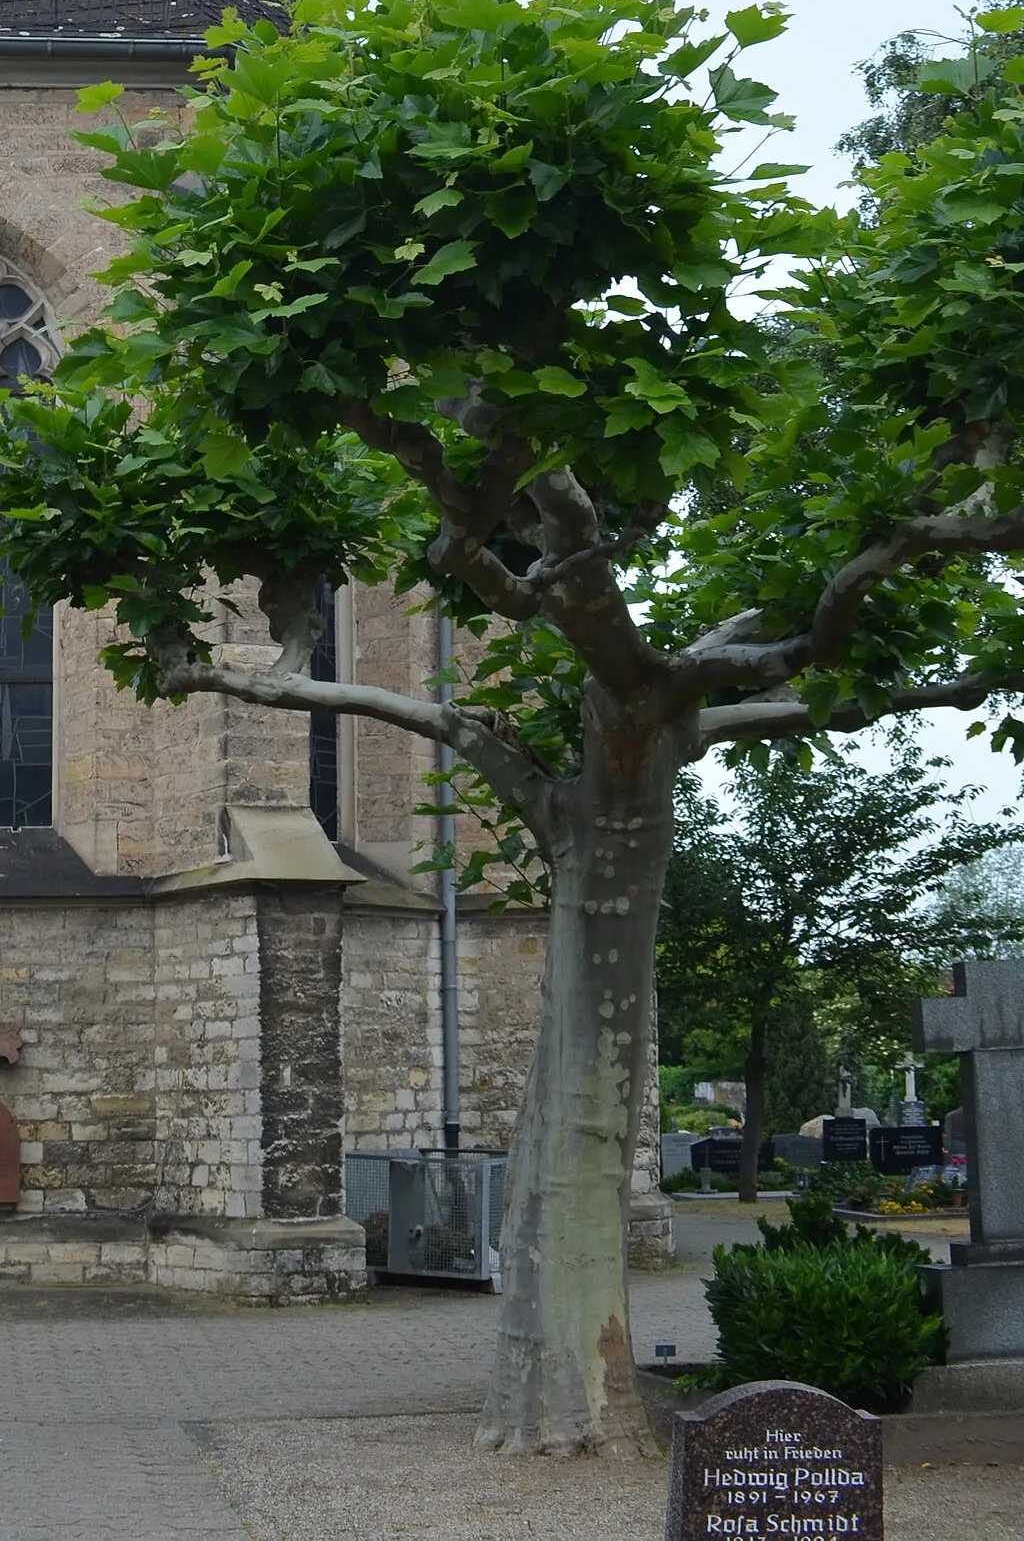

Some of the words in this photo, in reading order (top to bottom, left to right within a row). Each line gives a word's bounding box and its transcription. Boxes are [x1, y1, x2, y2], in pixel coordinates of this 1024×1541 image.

[766, 1429, 802, 1443] Hier
[725, 1446, 760, 1462] ruht
[763, 1447, 778, 1460] in
[784, 1446, 843, 1460] Frieden
[703, 1468, 789, 1490] Hedwig
[794, 1467, 865, 1486] Pollda
[727, 1491, 767, 1504] 1891
[794, 1490, 840, 1504] 1967
[766, 1513, 860, 1535] Schmidt
